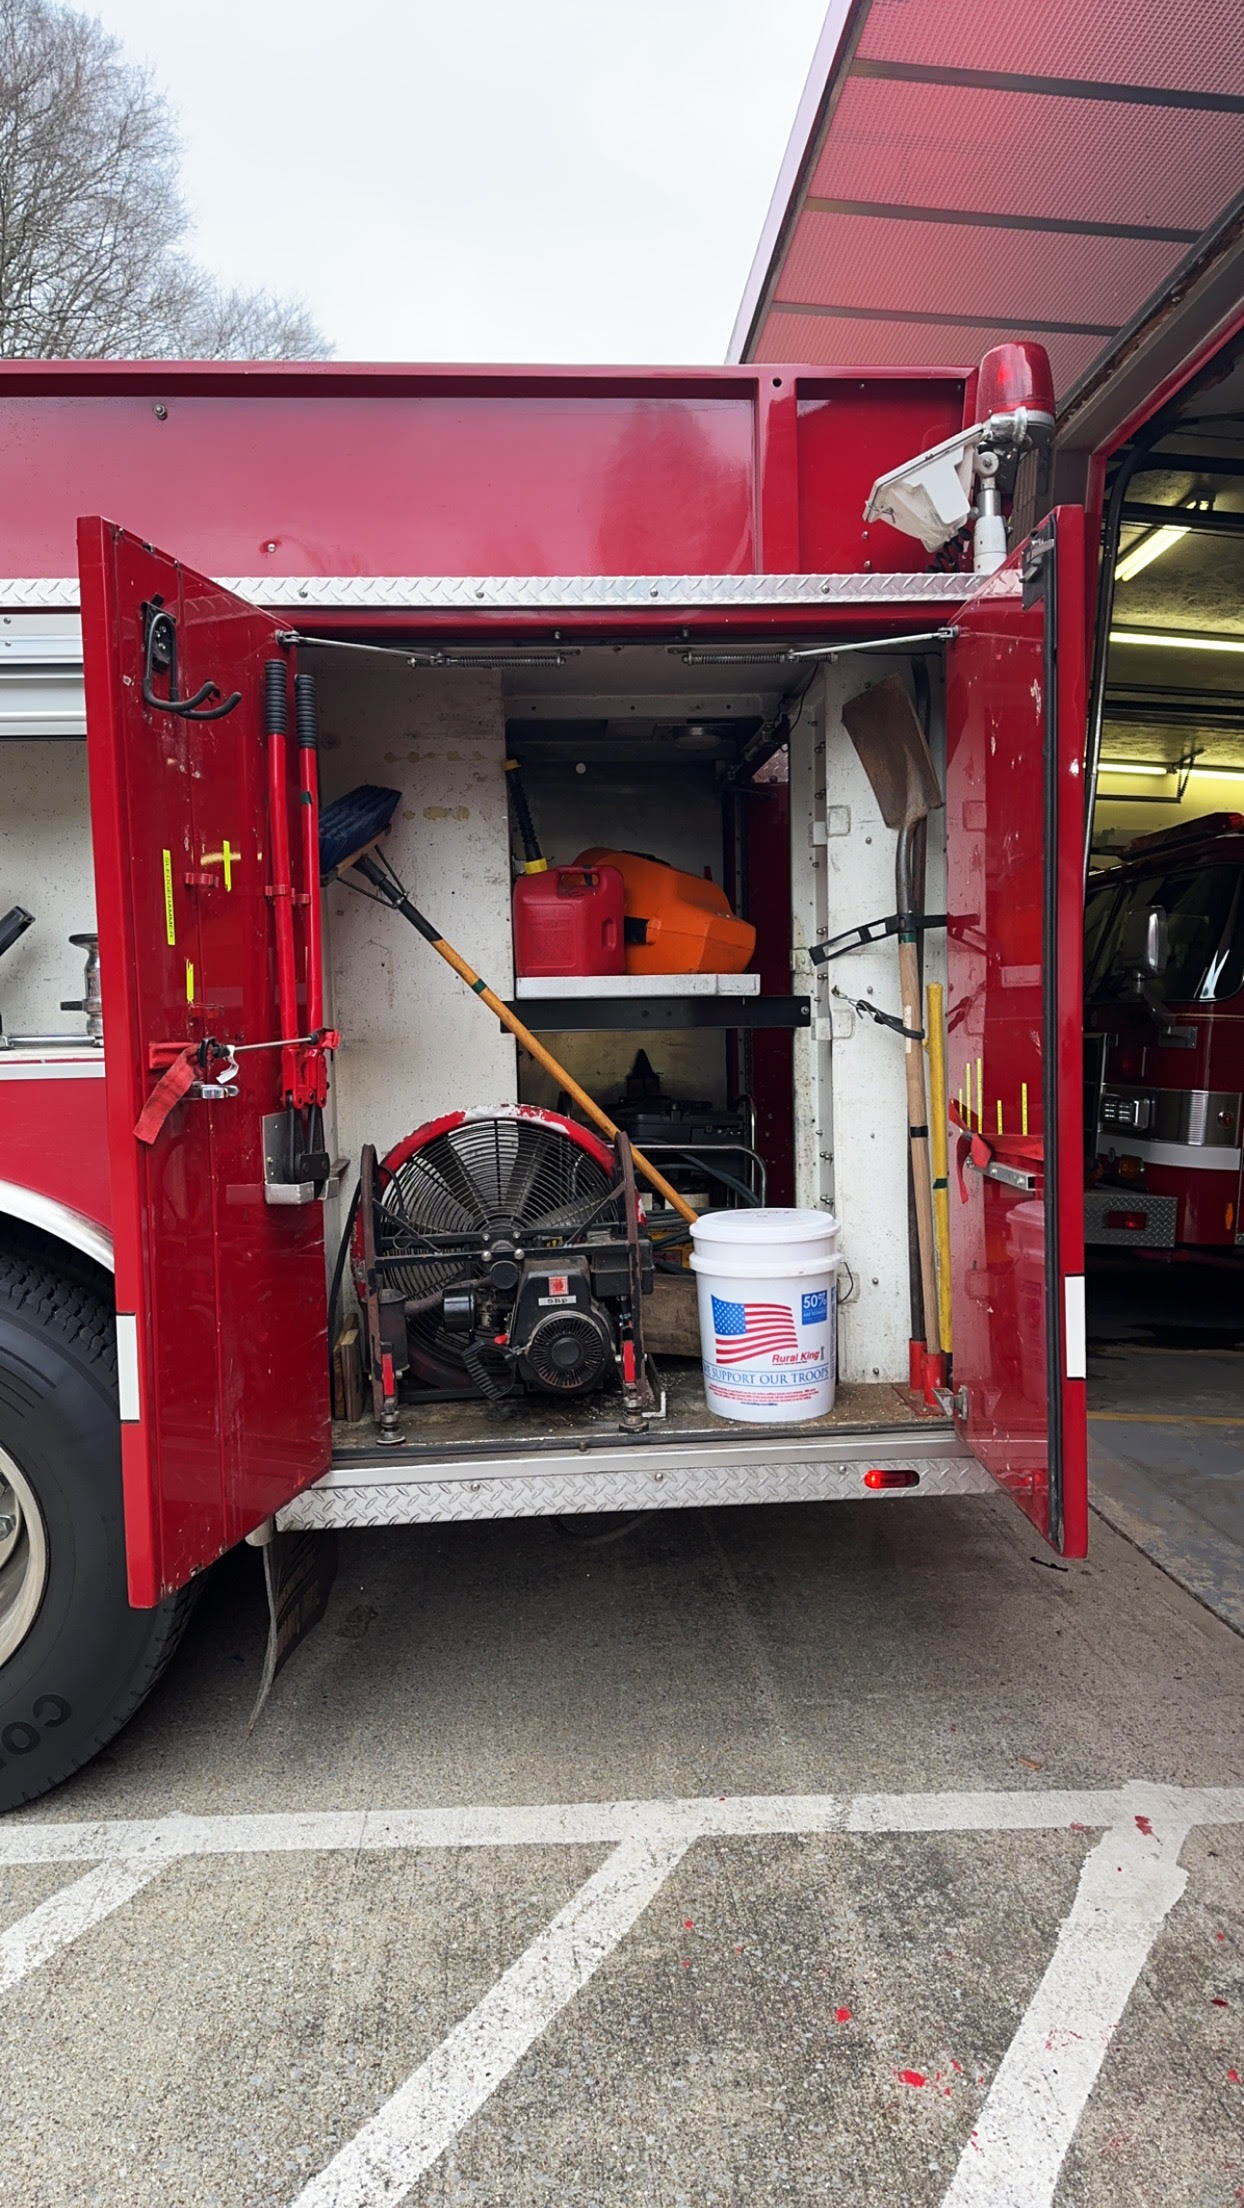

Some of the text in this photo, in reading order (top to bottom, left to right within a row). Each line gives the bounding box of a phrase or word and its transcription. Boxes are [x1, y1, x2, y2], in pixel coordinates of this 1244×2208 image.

[803, 1292, 826, 1309] 50%
[772, 1353, 799, 1363] Rural
[800, 1350, 820, 1361] King
[712, 1367, 756, 1384] SUPPORT
[759, 1374, 788, 1384] OUR
[0, 1694, 72, 1769] CO
